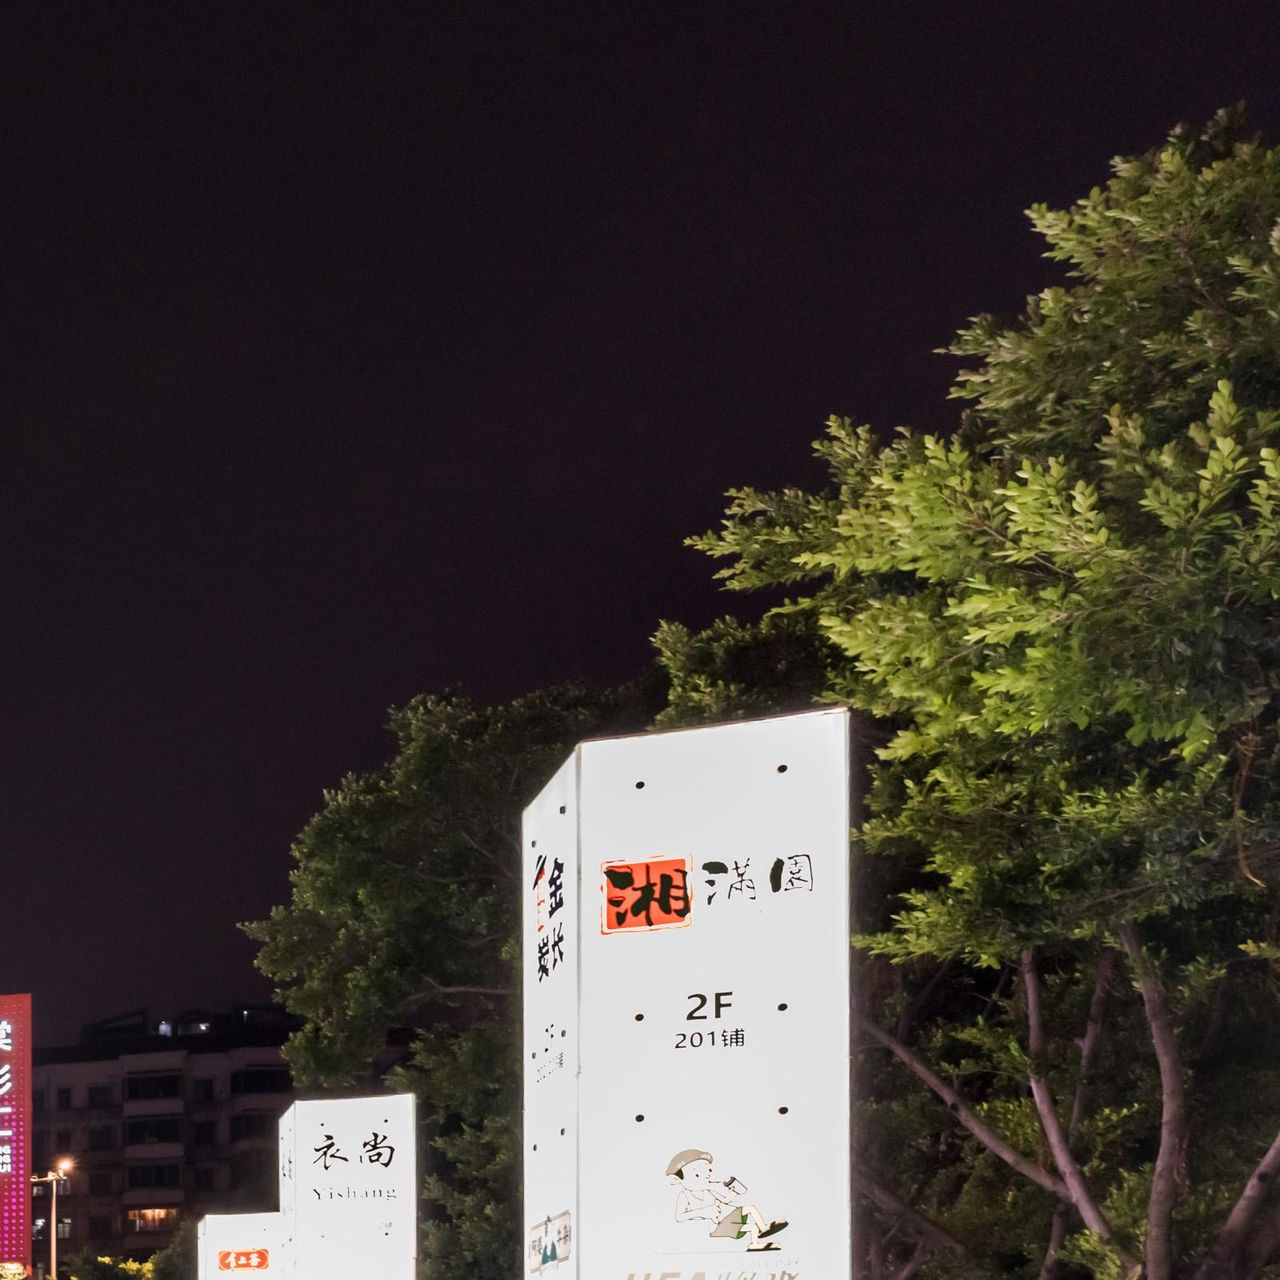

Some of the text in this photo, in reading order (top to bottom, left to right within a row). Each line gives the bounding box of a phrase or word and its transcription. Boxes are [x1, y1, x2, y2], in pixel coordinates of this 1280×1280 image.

[686, 991, 734, 1021] 2F
[674, 1028, 746, 1049] 201铺
[313, 1131, 396, 1171] 衣尚
